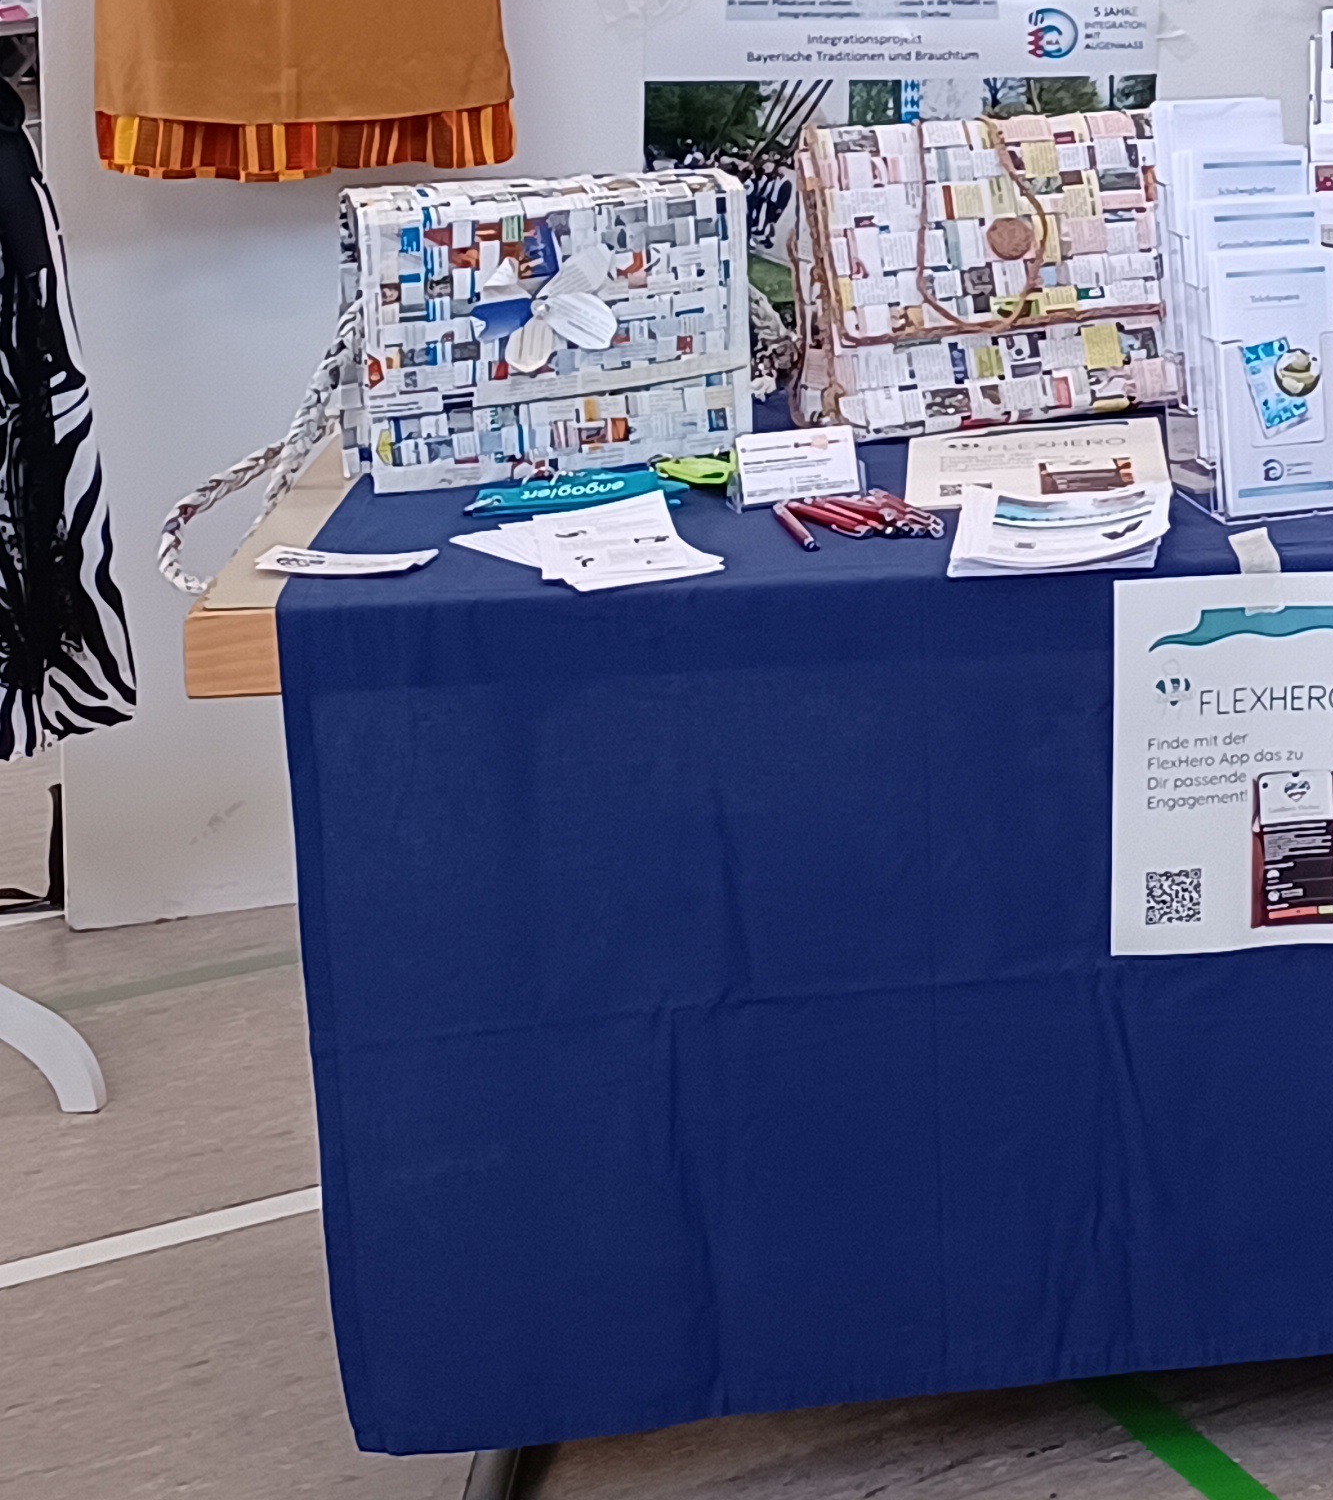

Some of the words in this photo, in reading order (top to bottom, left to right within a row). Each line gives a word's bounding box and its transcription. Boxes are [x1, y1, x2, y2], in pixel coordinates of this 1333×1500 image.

[807, 33, 922, 46] Integrationsprojekt
[746, 51, 812, 64] Bayerische
[816, 50, 885, 62] Traditionen
[888, 50, 911, 62] und
[915, 50, 979, 62] Brauchtum
[987, 436, 1127, 451] FLEXHERO
[1148, 736, 1190, 751] Finde
[1194, 734, 1218, 749] mit
[1222, 732, 1249, 747] der
[1147, 754, 1216, 771] FlexHero
[1218, 751, 1250, 767] App
[1254, 749, 1282, 763] das
[1286, 750, 1304, 761] zu
[1147, 775, 1169, 791] Dir
[1173, 771, 1248, 792] passende
[1147, 788, 1249, 812] Engagement!
